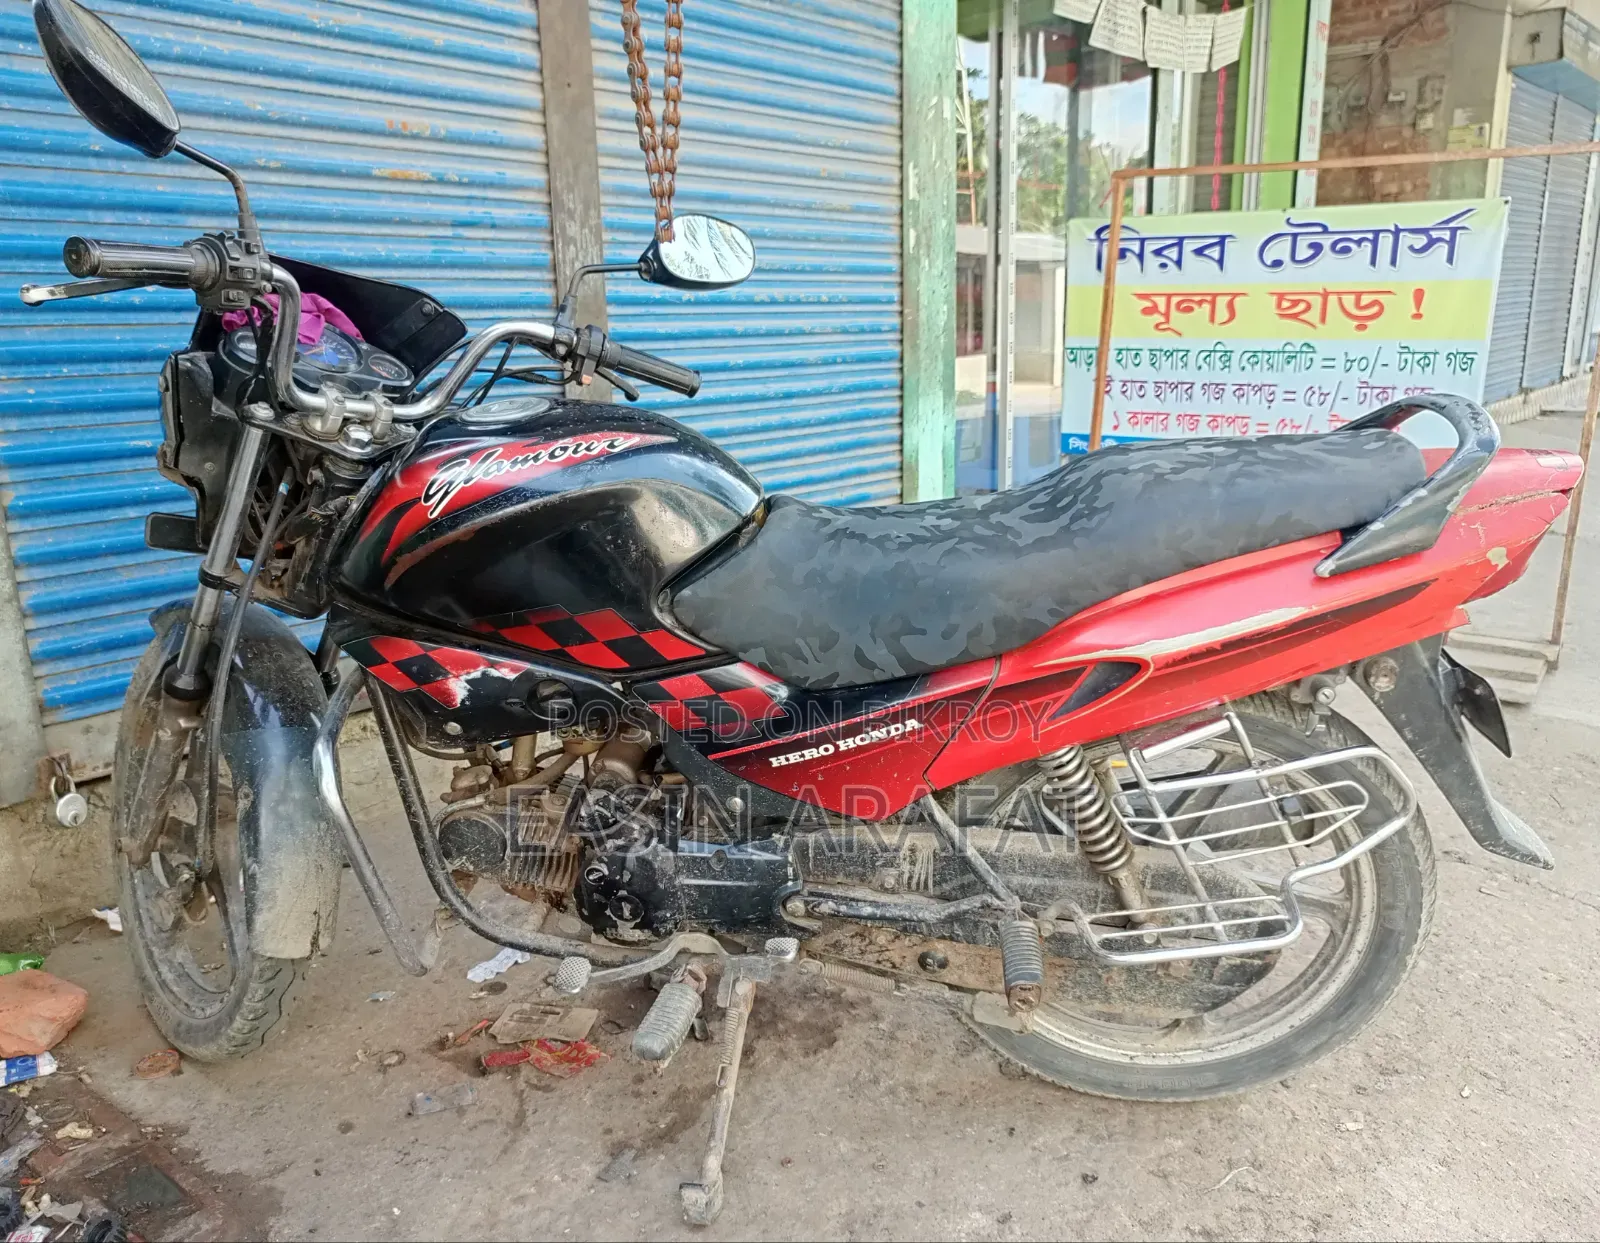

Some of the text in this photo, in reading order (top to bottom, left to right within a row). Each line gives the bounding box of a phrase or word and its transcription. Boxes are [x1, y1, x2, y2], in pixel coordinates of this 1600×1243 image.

[1087, 208, 1477, 274] নিরব টেলার্স
[1132, 287, 1425, 337] মূল্য ছাড় !
[1114, 347, 1143, 370] হাত
[1148, 347, 1190, 373] ছাপার
[1239, 342, 1317, 374] কোয়ালিটি
[1397, 342, 1440, 375] টাকা
[1446, 350, 1478, 376] গজ
[1119, 379, 1148, 402] হাত
[1153, 380, 1195, 405] ছাপার
[1202, 381, 1228, 405] গজ
[1231, 382, 1277, 410] কাপড়
[1356, 377, 1396, 409] টাকা
[1126, 408, 1170, 433] কালার
[1176, 413, 1202, 434] গজ
[769, 718, 924, 768] HERO HONDA
